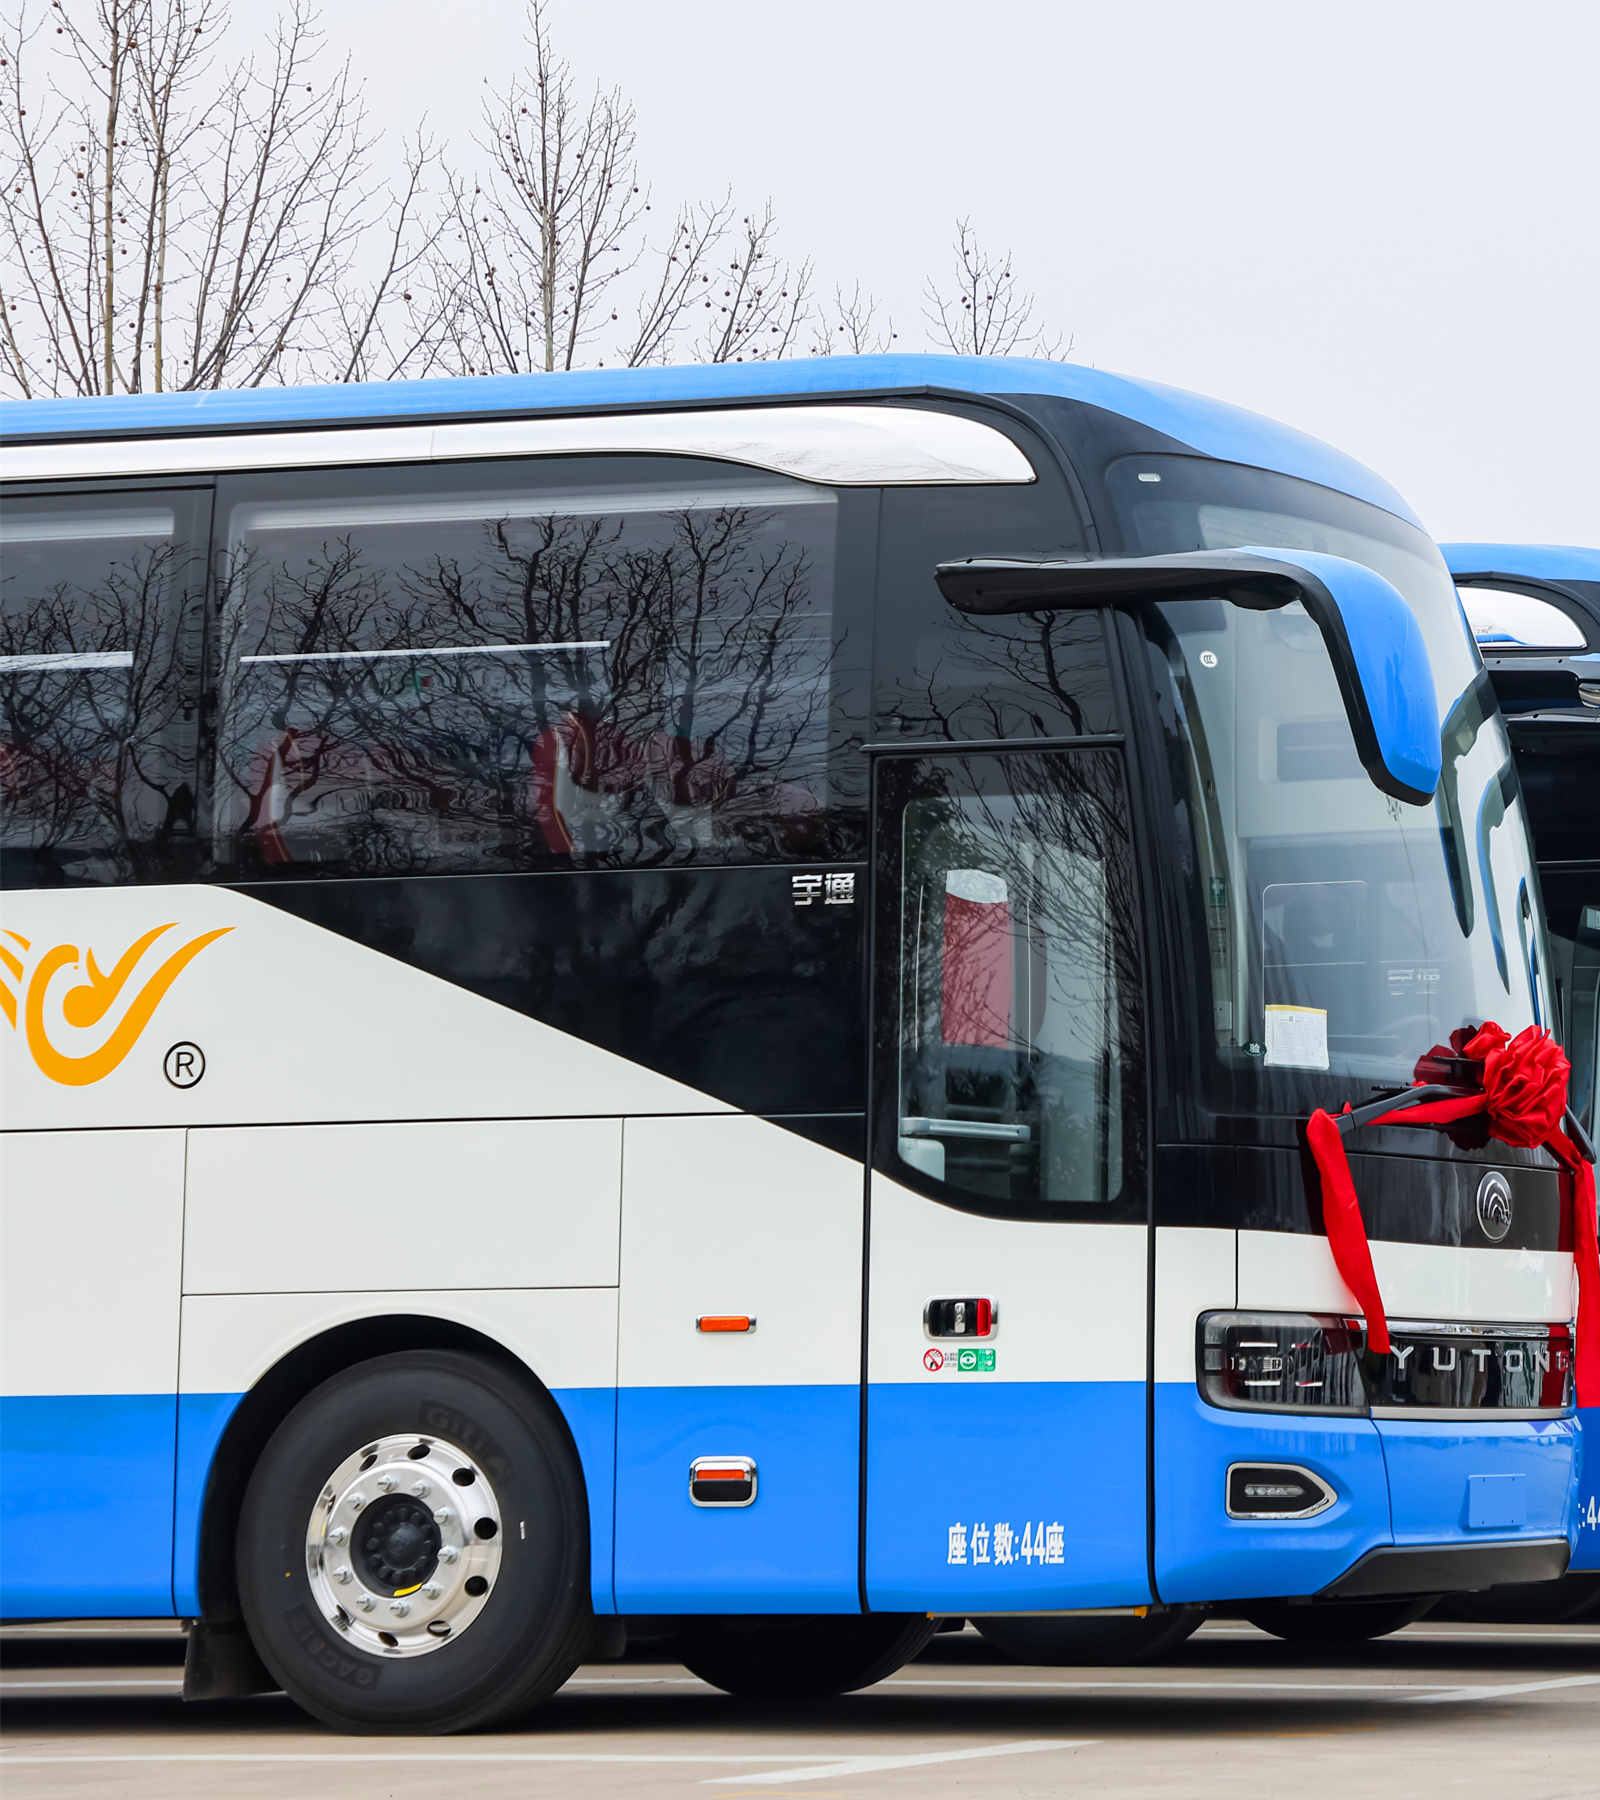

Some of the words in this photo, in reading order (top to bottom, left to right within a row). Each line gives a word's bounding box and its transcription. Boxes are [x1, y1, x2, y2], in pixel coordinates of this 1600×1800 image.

[792, 872, 855, 906] 宇通
[1389, 1345, 1570, 1372] YUTONG
[426, 1406, 488, 1451] Giti
[947, 1521, 1065, 1566] 座位数:44座
